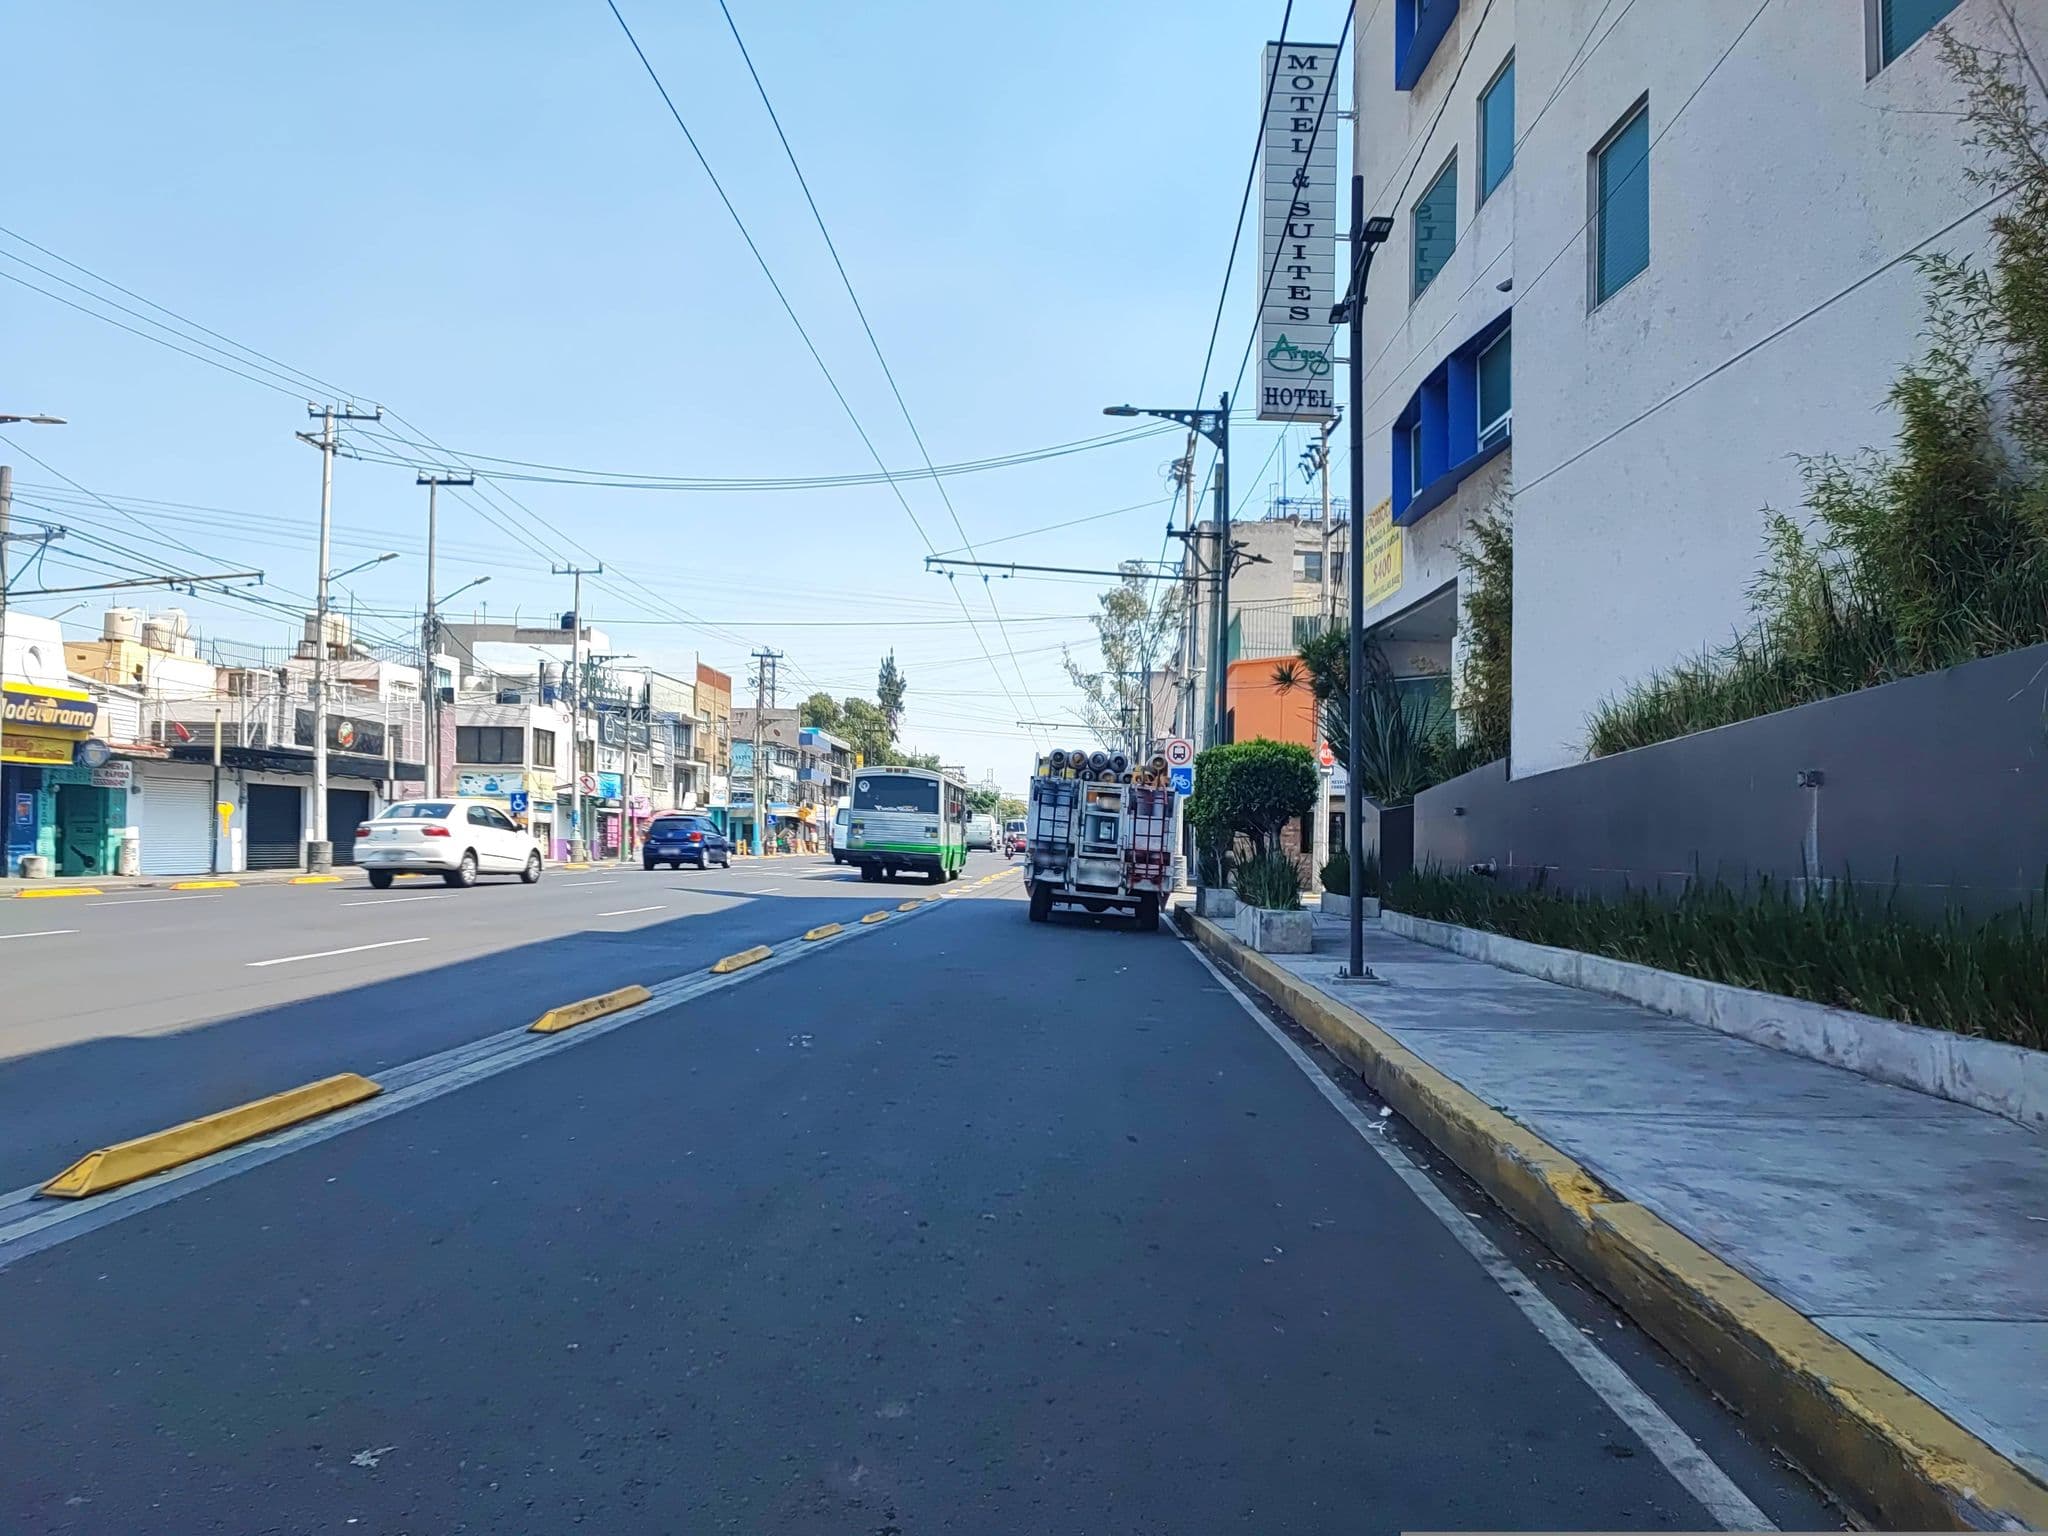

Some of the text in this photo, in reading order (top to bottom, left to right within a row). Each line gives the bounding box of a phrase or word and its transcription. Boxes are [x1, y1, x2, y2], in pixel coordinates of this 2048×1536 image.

[1287, 54, 1318, 321] MOTEL & SUITES
[1267, 333, 1330, 375] Argos
[1264, 387, 1332, 408] HOTEL
